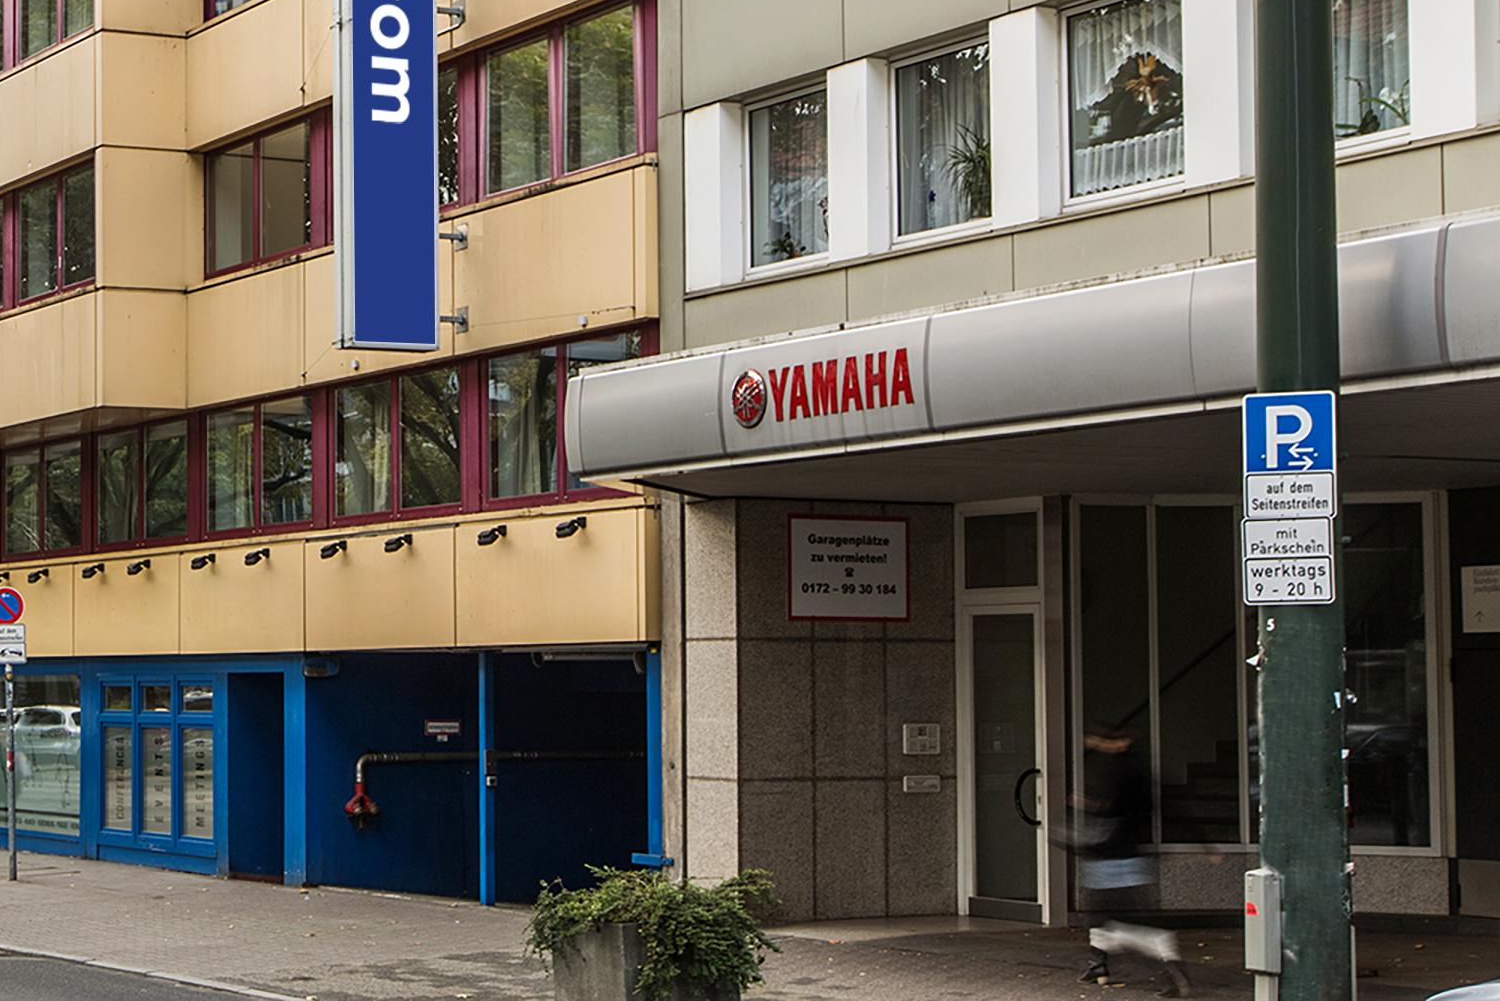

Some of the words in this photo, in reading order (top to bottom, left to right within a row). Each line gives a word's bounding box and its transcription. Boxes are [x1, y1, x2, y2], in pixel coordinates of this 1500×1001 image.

[768, 347, 915, 423] YAMAHA
[1266, 404, 1313, 469] P
[1266, 481, 1284, 494] auf
[1290, 481, 1313, 494] dem
[1252, 496, 1329, 510] Seitenstreifen
[808, 533, 890, 547] Garagenplätze
[1276, 528, 1297, 539] mit
[1251, 542, 1324, 555] Parkschein
[811, 553, 824, 562] zu
[827, 553, 887, 564] vermieten!
[1251, 565, 1326, 580] werktags
[802, 583, 830, 594] 0172
[841, 584, 856, 594] 99
[859, 584, 873, 595] 30
[876, 584, 896, 595] 184
[1255, 583, 1263, 596] 9
[1287, 582, 1306, 596] 20
[1314, 583, 1322, 595] h
[1266, 618, 1275, 631] 5
[154, 737, 164, 823] EVENTS
[195, 740, 205, 828] MEETINGS
